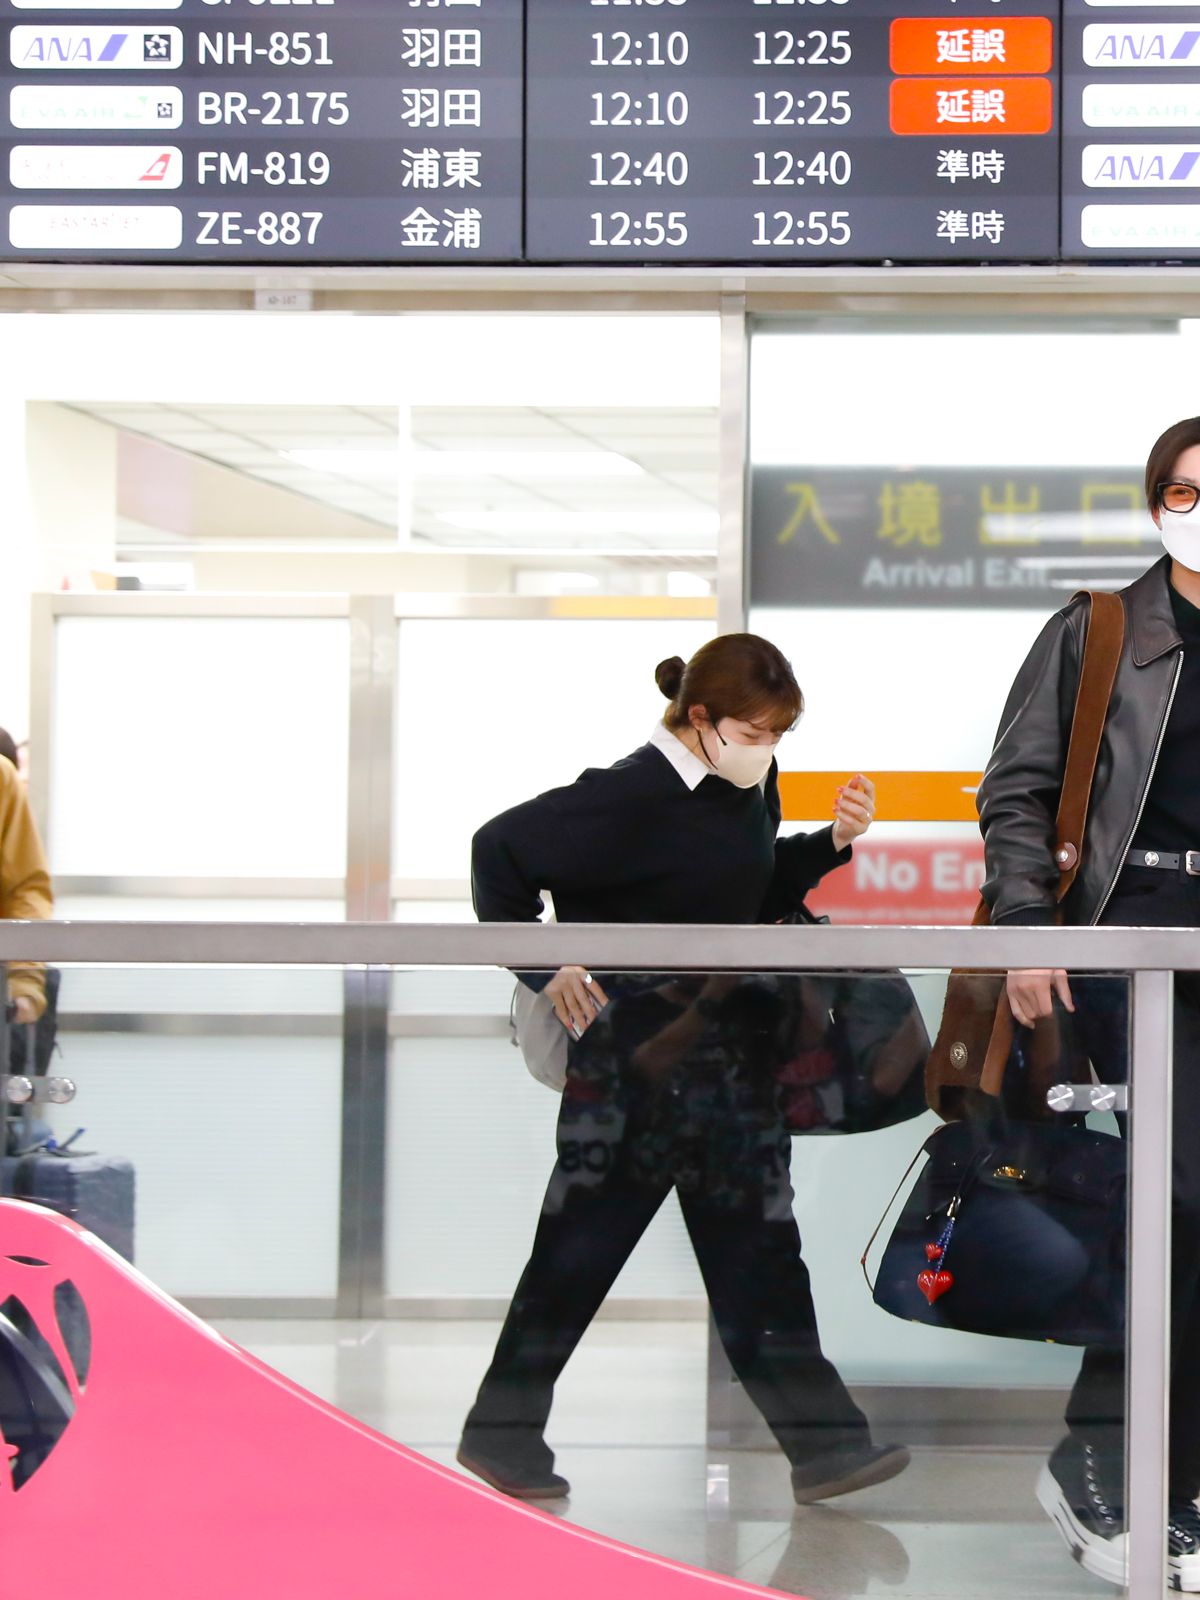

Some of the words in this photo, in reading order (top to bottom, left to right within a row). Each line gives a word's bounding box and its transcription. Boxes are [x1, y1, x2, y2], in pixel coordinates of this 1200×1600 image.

[23, 37, 92, 62] ANA
[198, 31, 334, 66] NH-851
[400, 28, 481, 68] 羽田
[590, 31, 689, 66] 12:10
[752, 30, 852, 65] 12:25
[936, 28, 1006, 64] 延誤
[1095, 34, 1166, 60] ANA
[198, 91, 350, 126] BR-2175
[400, 88, 481, 128] 羽田
[589, 91, 689, 126] 12:10
[752, 90, 852, 125] 12:25
[935, 88, 1006, 124] 延誤
[197, 151, 330, 186] FM-819
[400, 147, 482, 189] 浦東
[589, 151, 689, 186] 12:40
[752, 150, 852, 186] 12:40
[936, 149, 1006, 184] 準時
[1094, 155, 1165, 181] ANA
[195, 211, 324, 246] ZE-887
[400, 206, 483, 249] 金浦
[588, 211, 688, 246] 12:55
[751, 210, 851, 246] 12:55
[936, 209, 1005, 244] 準時
[778, 481, 1141, 547] 入境出口
[863, 558, 975, 588] Arrival
[986, 558, 1051, 588] Exit
[856, 853, 920, 891] No
